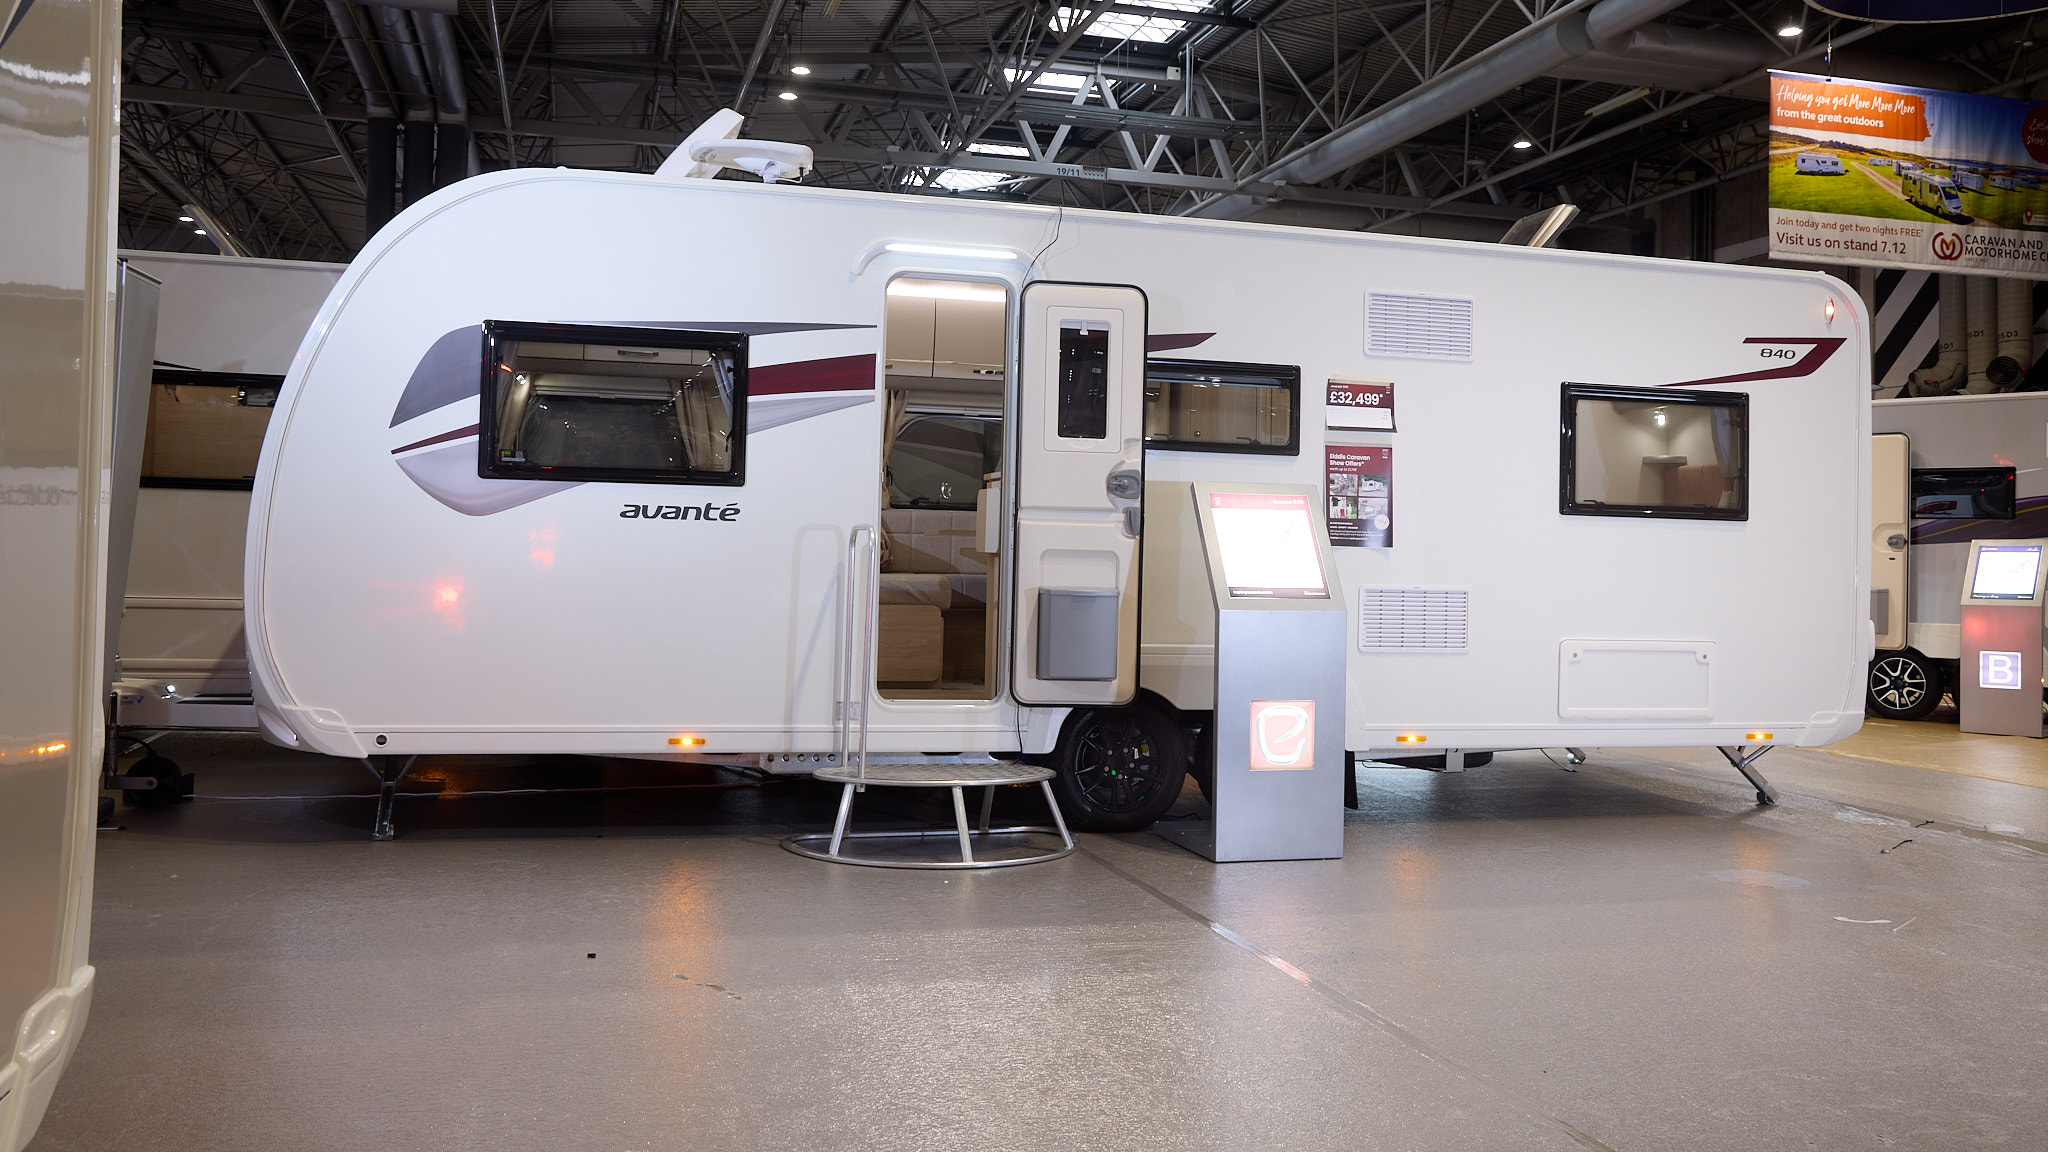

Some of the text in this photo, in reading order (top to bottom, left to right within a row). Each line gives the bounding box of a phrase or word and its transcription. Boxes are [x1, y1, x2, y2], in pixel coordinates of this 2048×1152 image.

[1776, 85, 1916, 115] Helping you get More More More
[1776, 107, 1884, 128] from the great outdoors
[1056, 167, 1081, 177] 19/11
[1776, 216, 1794, 226] Join
[1795, 218, 1820, 231] today
[1821, 221, 1837, 230] and
[1839, 223, 1853, 233] get
[1855, 224, 1871, 233] two
[1872, 225, 1898, 237] nights
[1776, 231, 1906, 255] Visit us on stand 7.12
[1964, 234, 2043, 250] CARAVAN AND
[1964, 246, 2037, 261] MOTORHOME
[1760, 348, 1796, 360] 840
[619, 502, 741, 522] avanté
[1988, 654, 2014, 684] B
